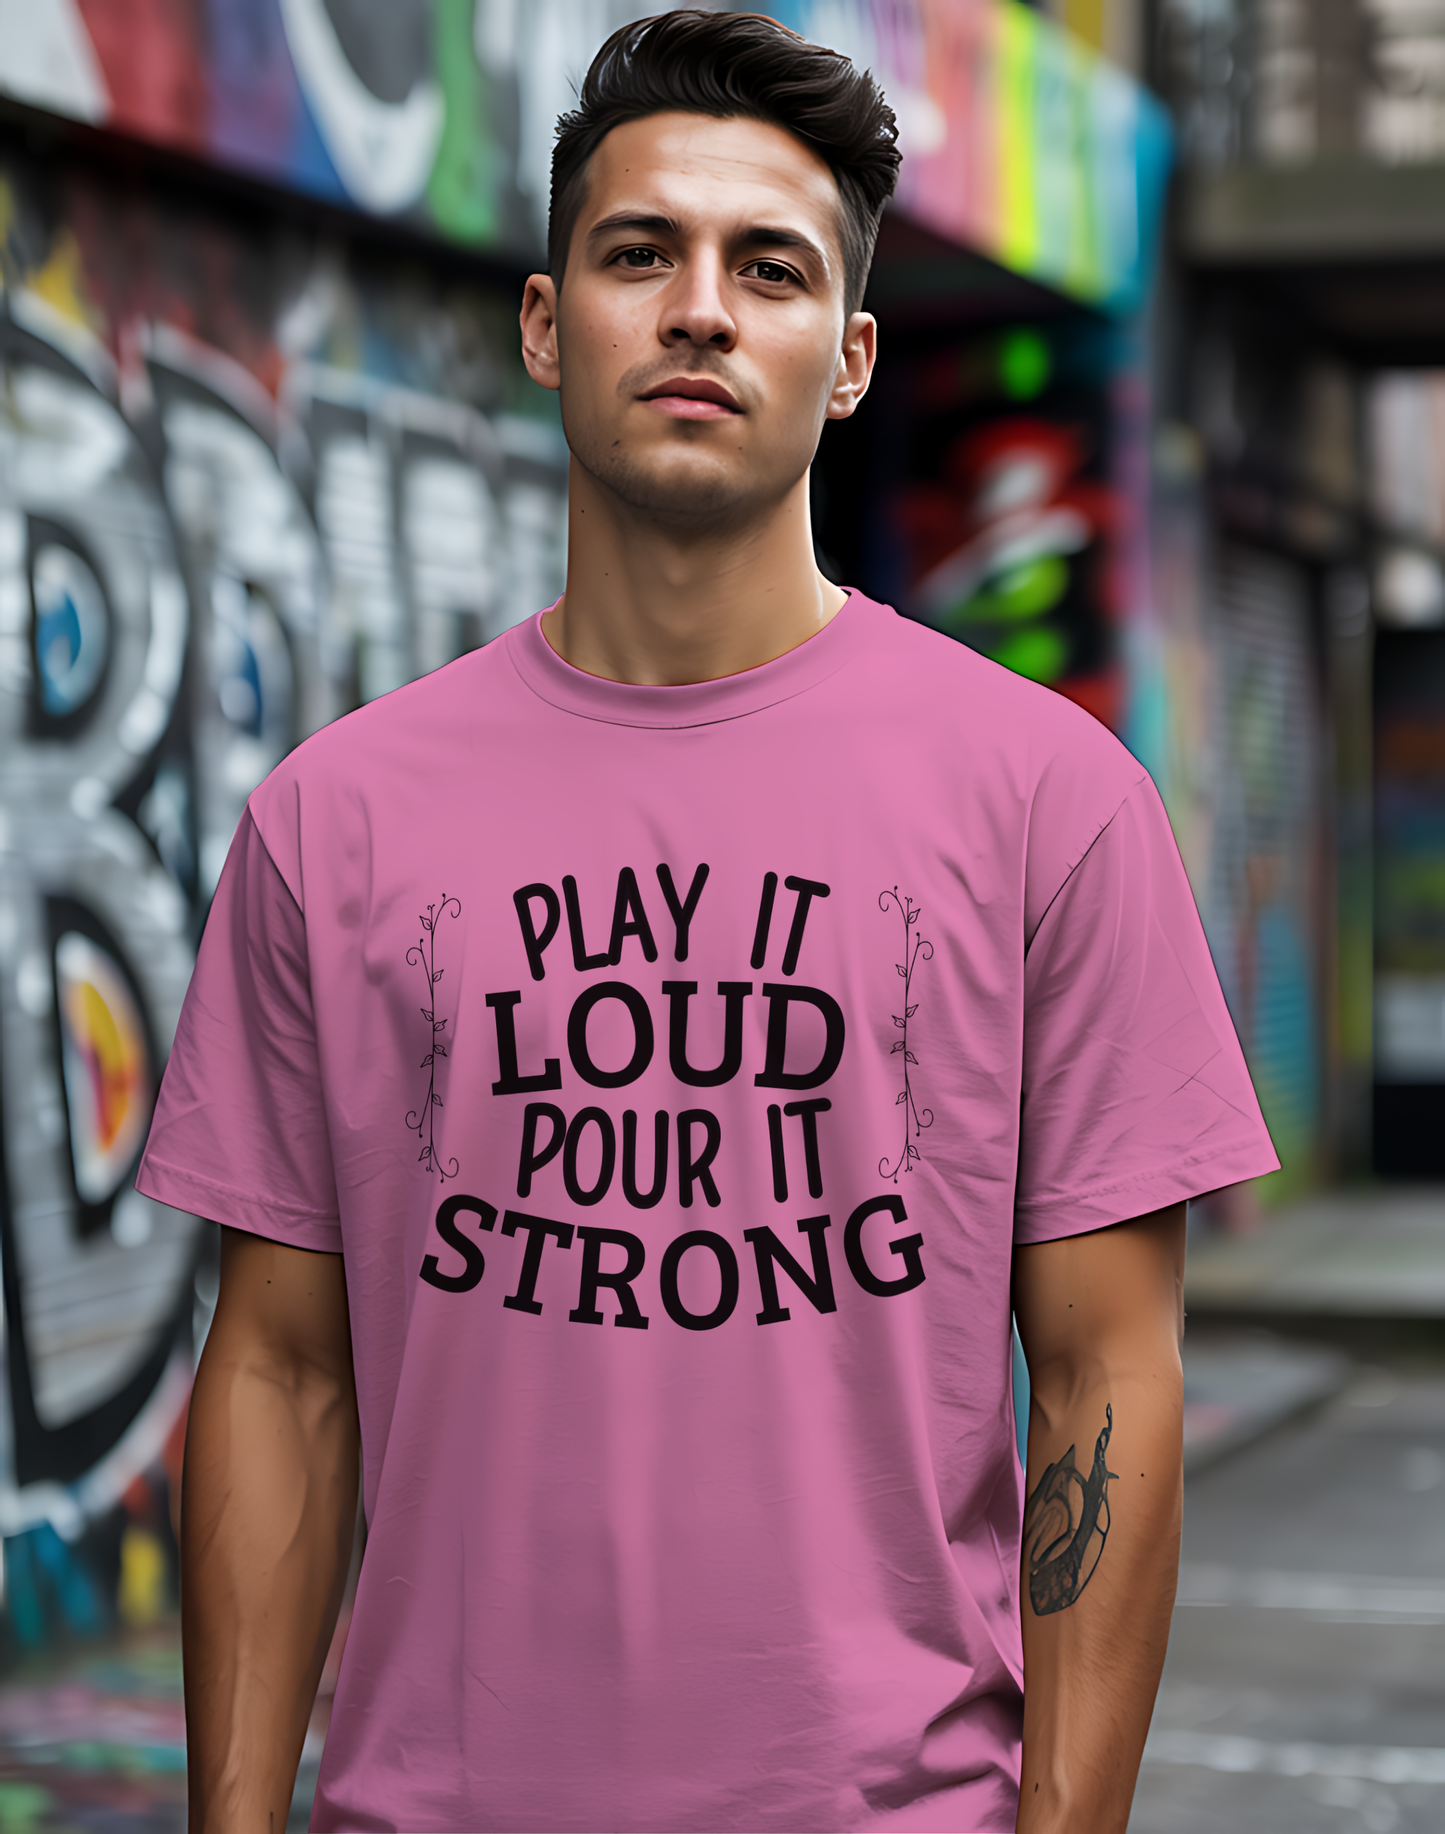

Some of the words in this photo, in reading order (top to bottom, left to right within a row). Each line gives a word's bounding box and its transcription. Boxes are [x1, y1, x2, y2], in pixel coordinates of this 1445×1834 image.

[513, 863, 710, 982] PLAY
[751, 872, 831, 977] IT
[486, 981, 846, 1096] LOUD
[517, 1103, 721, 1210] POUR
[767, 1098, 831, 1203] IT
[419, 1195, 927, 1331] STRONG
